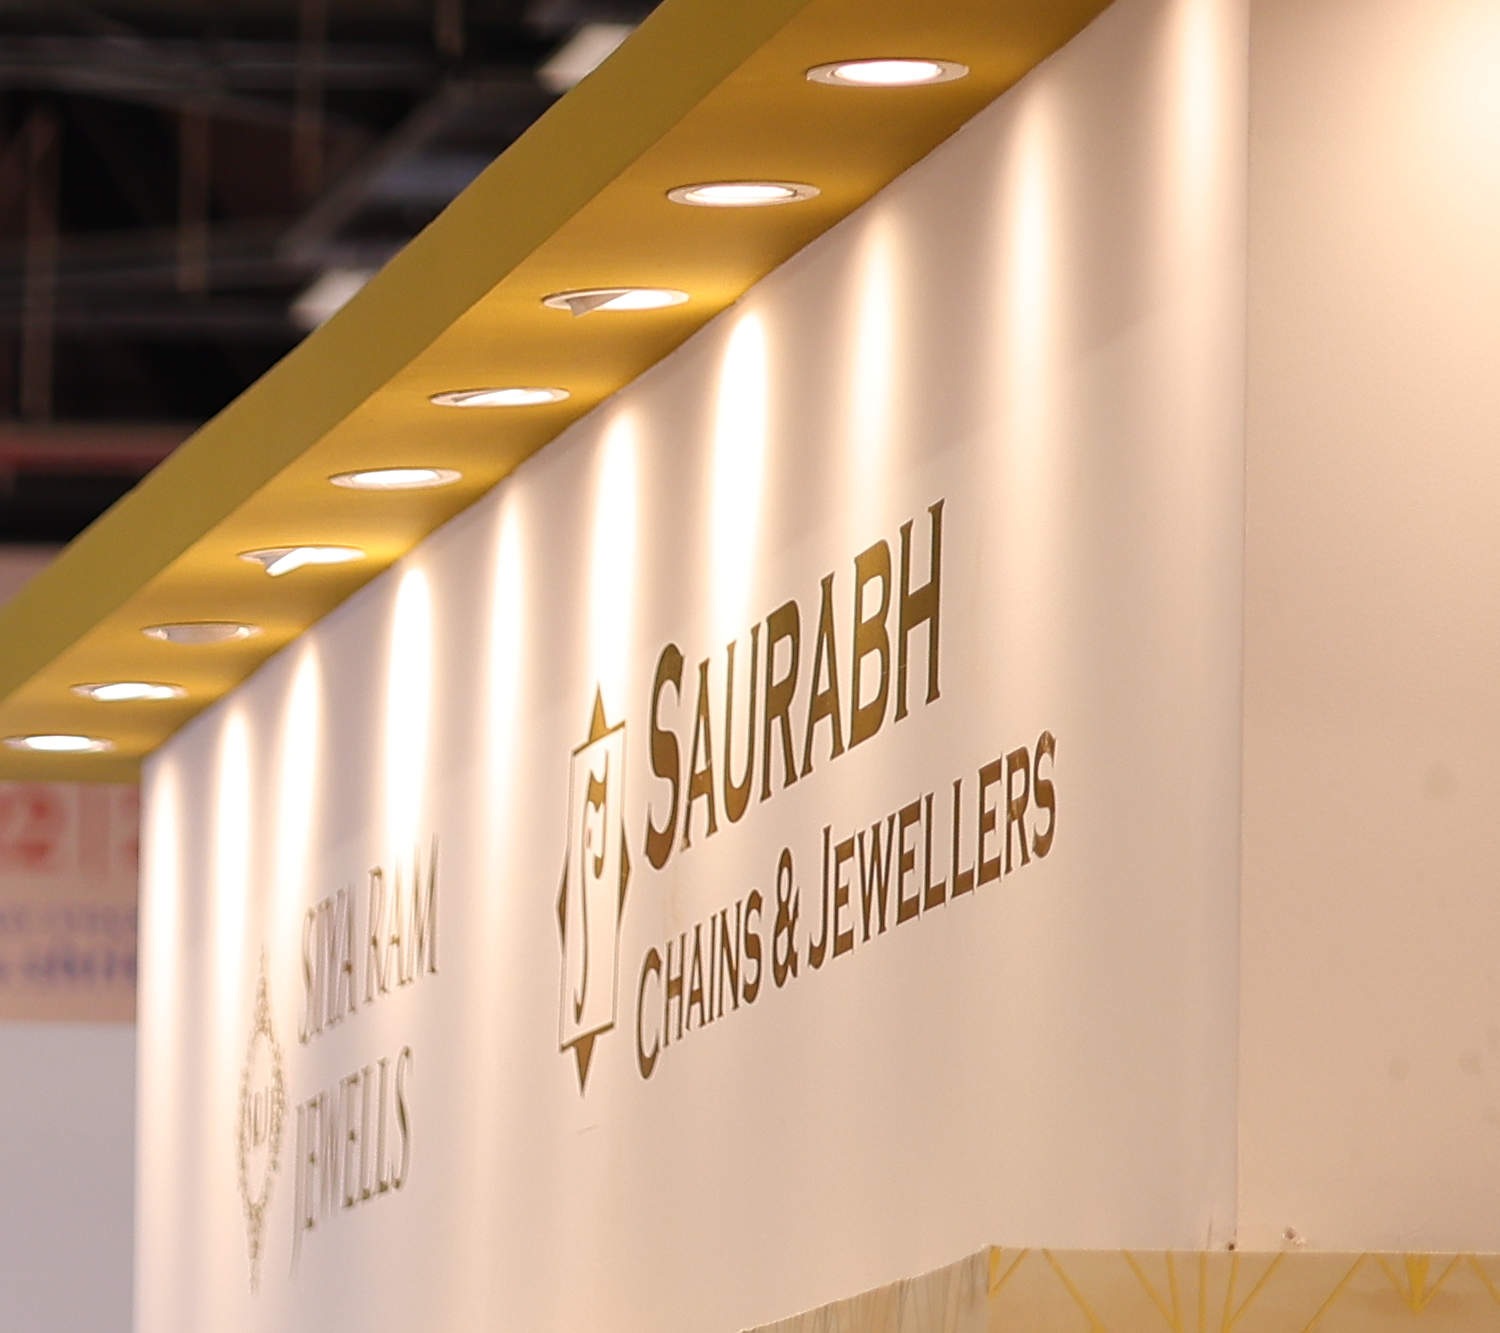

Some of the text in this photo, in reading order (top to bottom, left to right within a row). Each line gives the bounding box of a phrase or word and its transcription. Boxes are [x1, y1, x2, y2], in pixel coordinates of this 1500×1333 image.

[645, 498, 945, 870] SAURABH
[298, 832, 440, 1045] SIYA RAM
[635, 730, 1057, 1080] CHAINS & JEWELLERS
